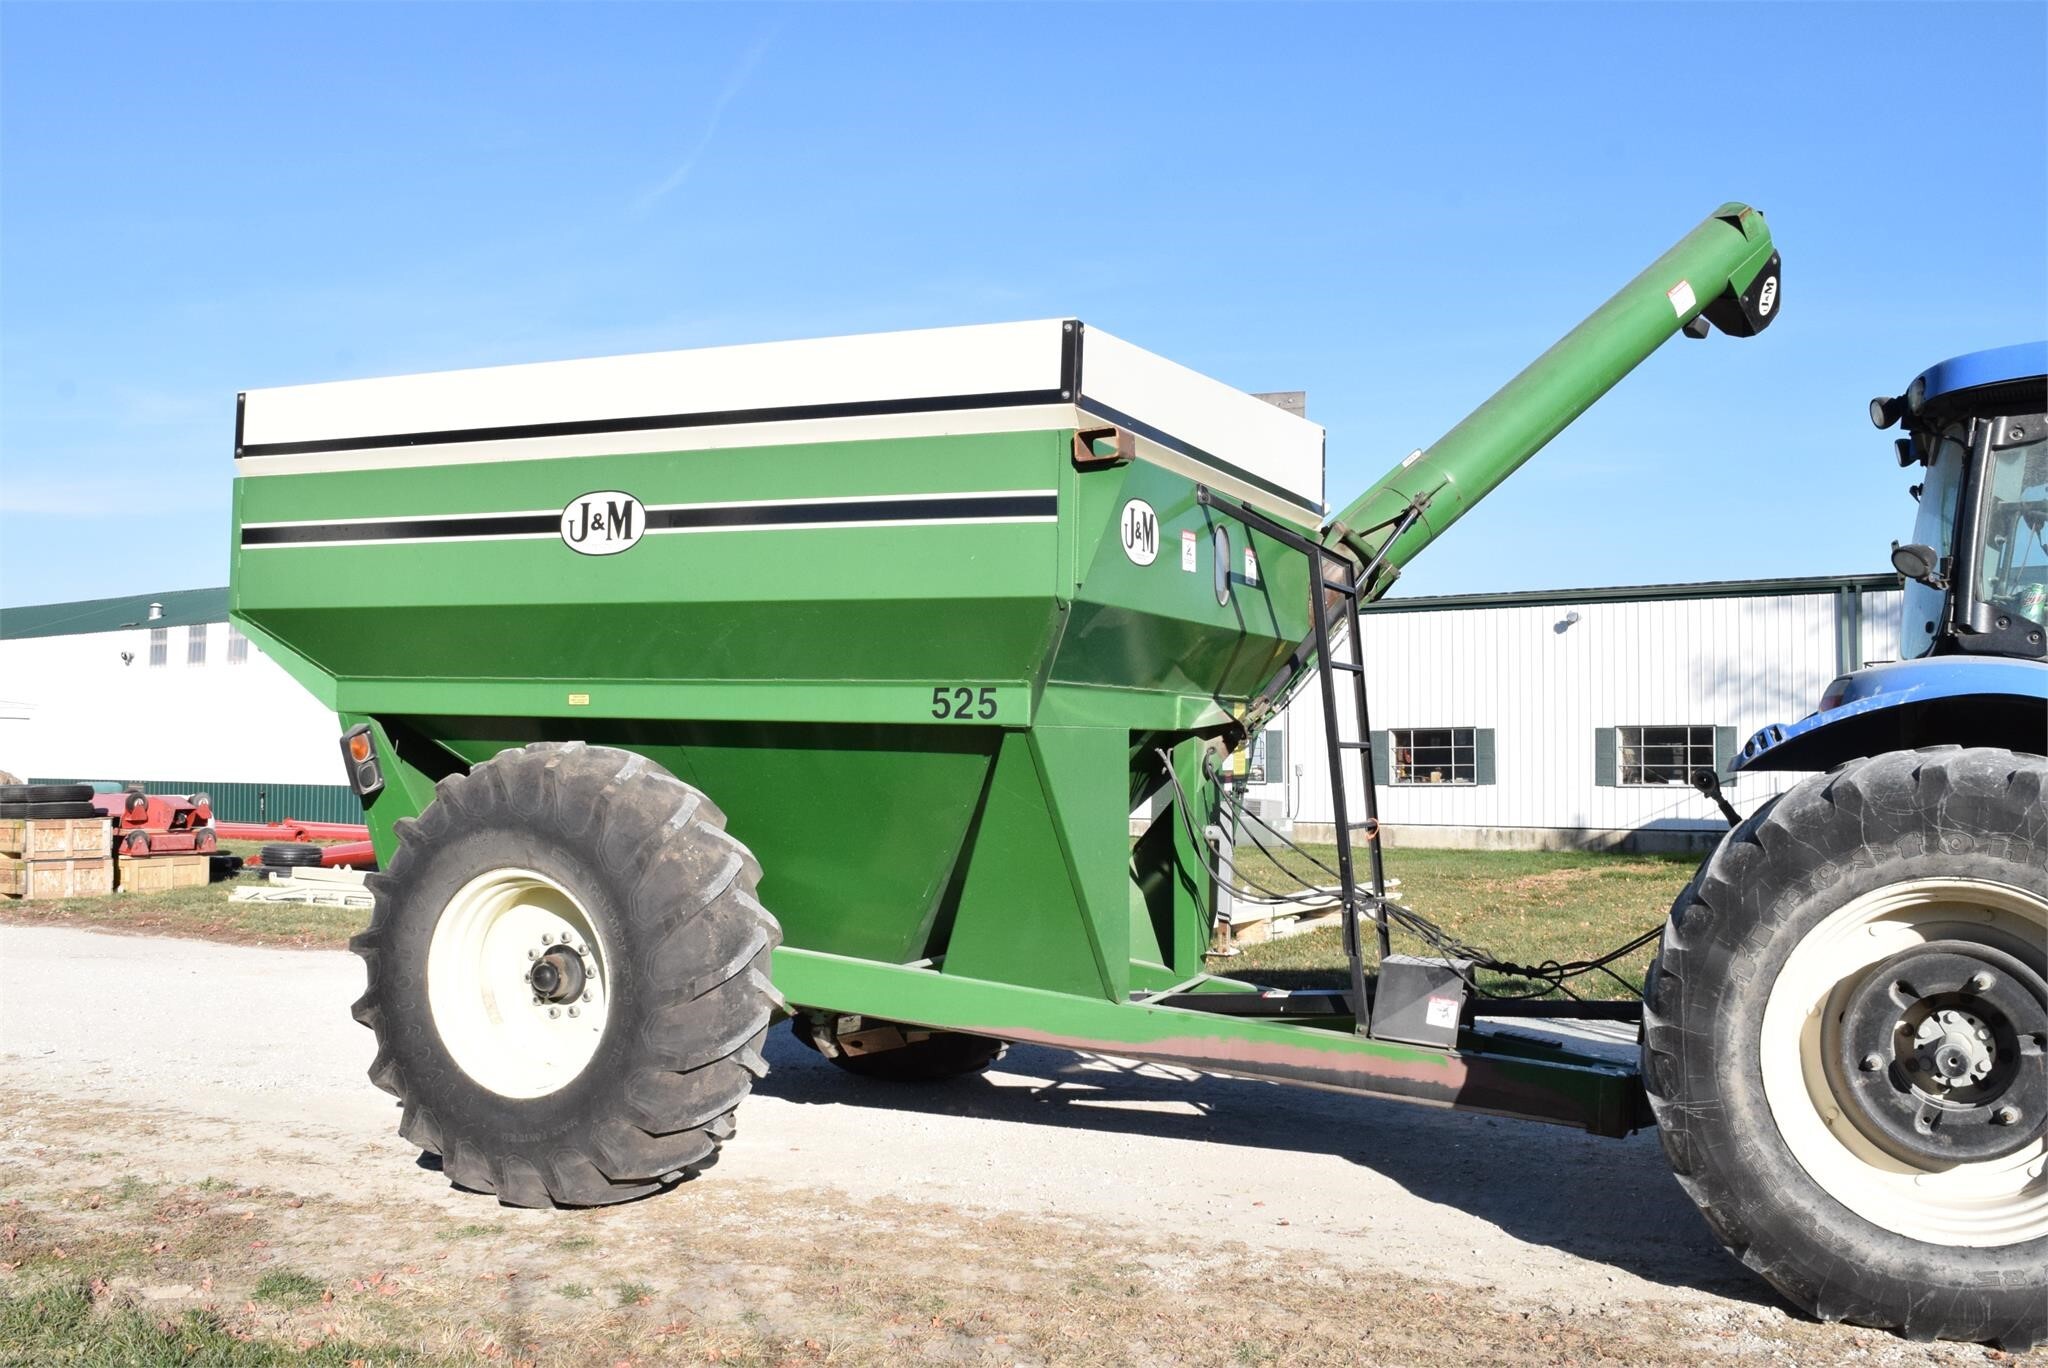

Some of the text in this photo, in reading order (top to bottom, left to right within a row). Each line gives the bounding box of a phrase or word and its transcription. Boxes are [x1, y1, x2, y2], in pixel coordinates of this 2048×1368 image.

[568, 500, 634, 542] J&M
[1125, 507, 1154, 554] J&M
[931, 687, 998, 720] 525
